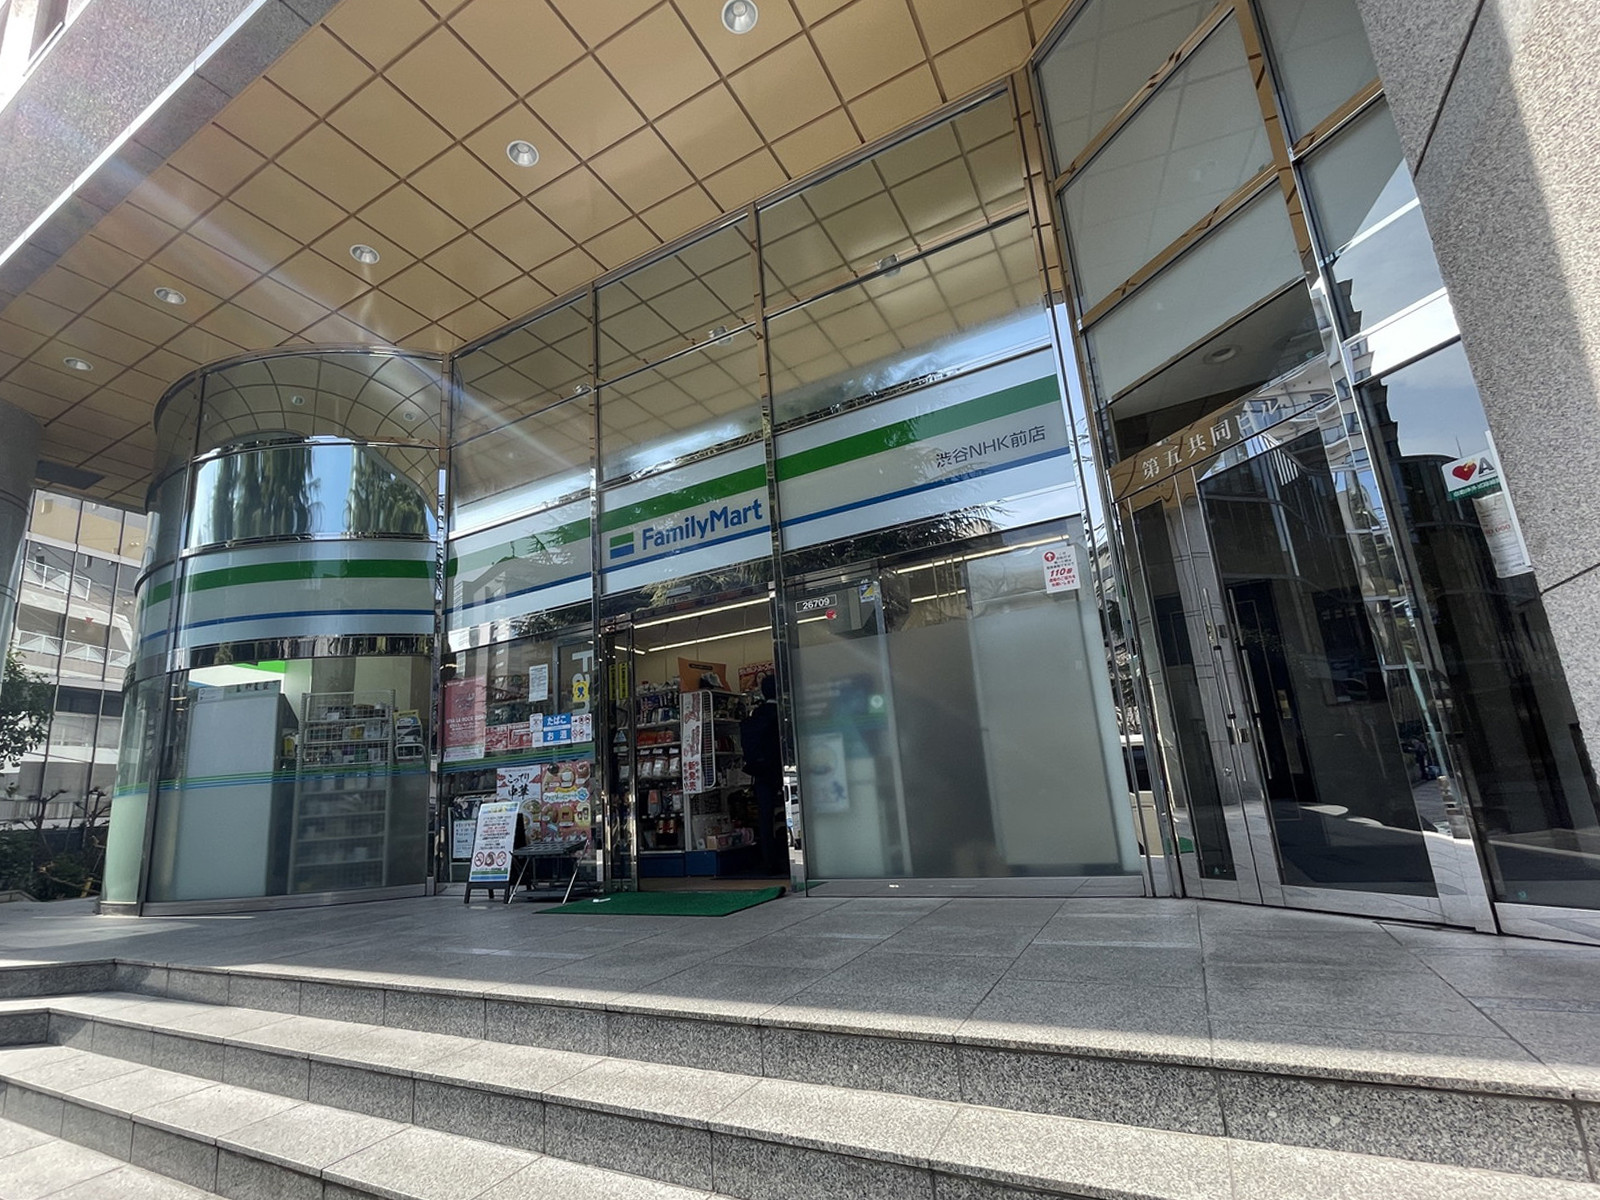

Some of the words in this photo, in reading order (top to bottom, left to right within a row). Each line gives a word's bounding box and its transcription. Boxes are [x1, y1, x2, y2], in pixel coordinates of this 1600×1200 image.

[935, 425, 1046, 468] 渋谷NHK前店
[1141, 398, 1280, 480] 第五共同ビル
[642, 498, 763, 551] FamilyMart
[802, 597, 830, 610] 26709
[546, 715, 567, 726] たばこ
[507, 772, 530, 784] こってり
